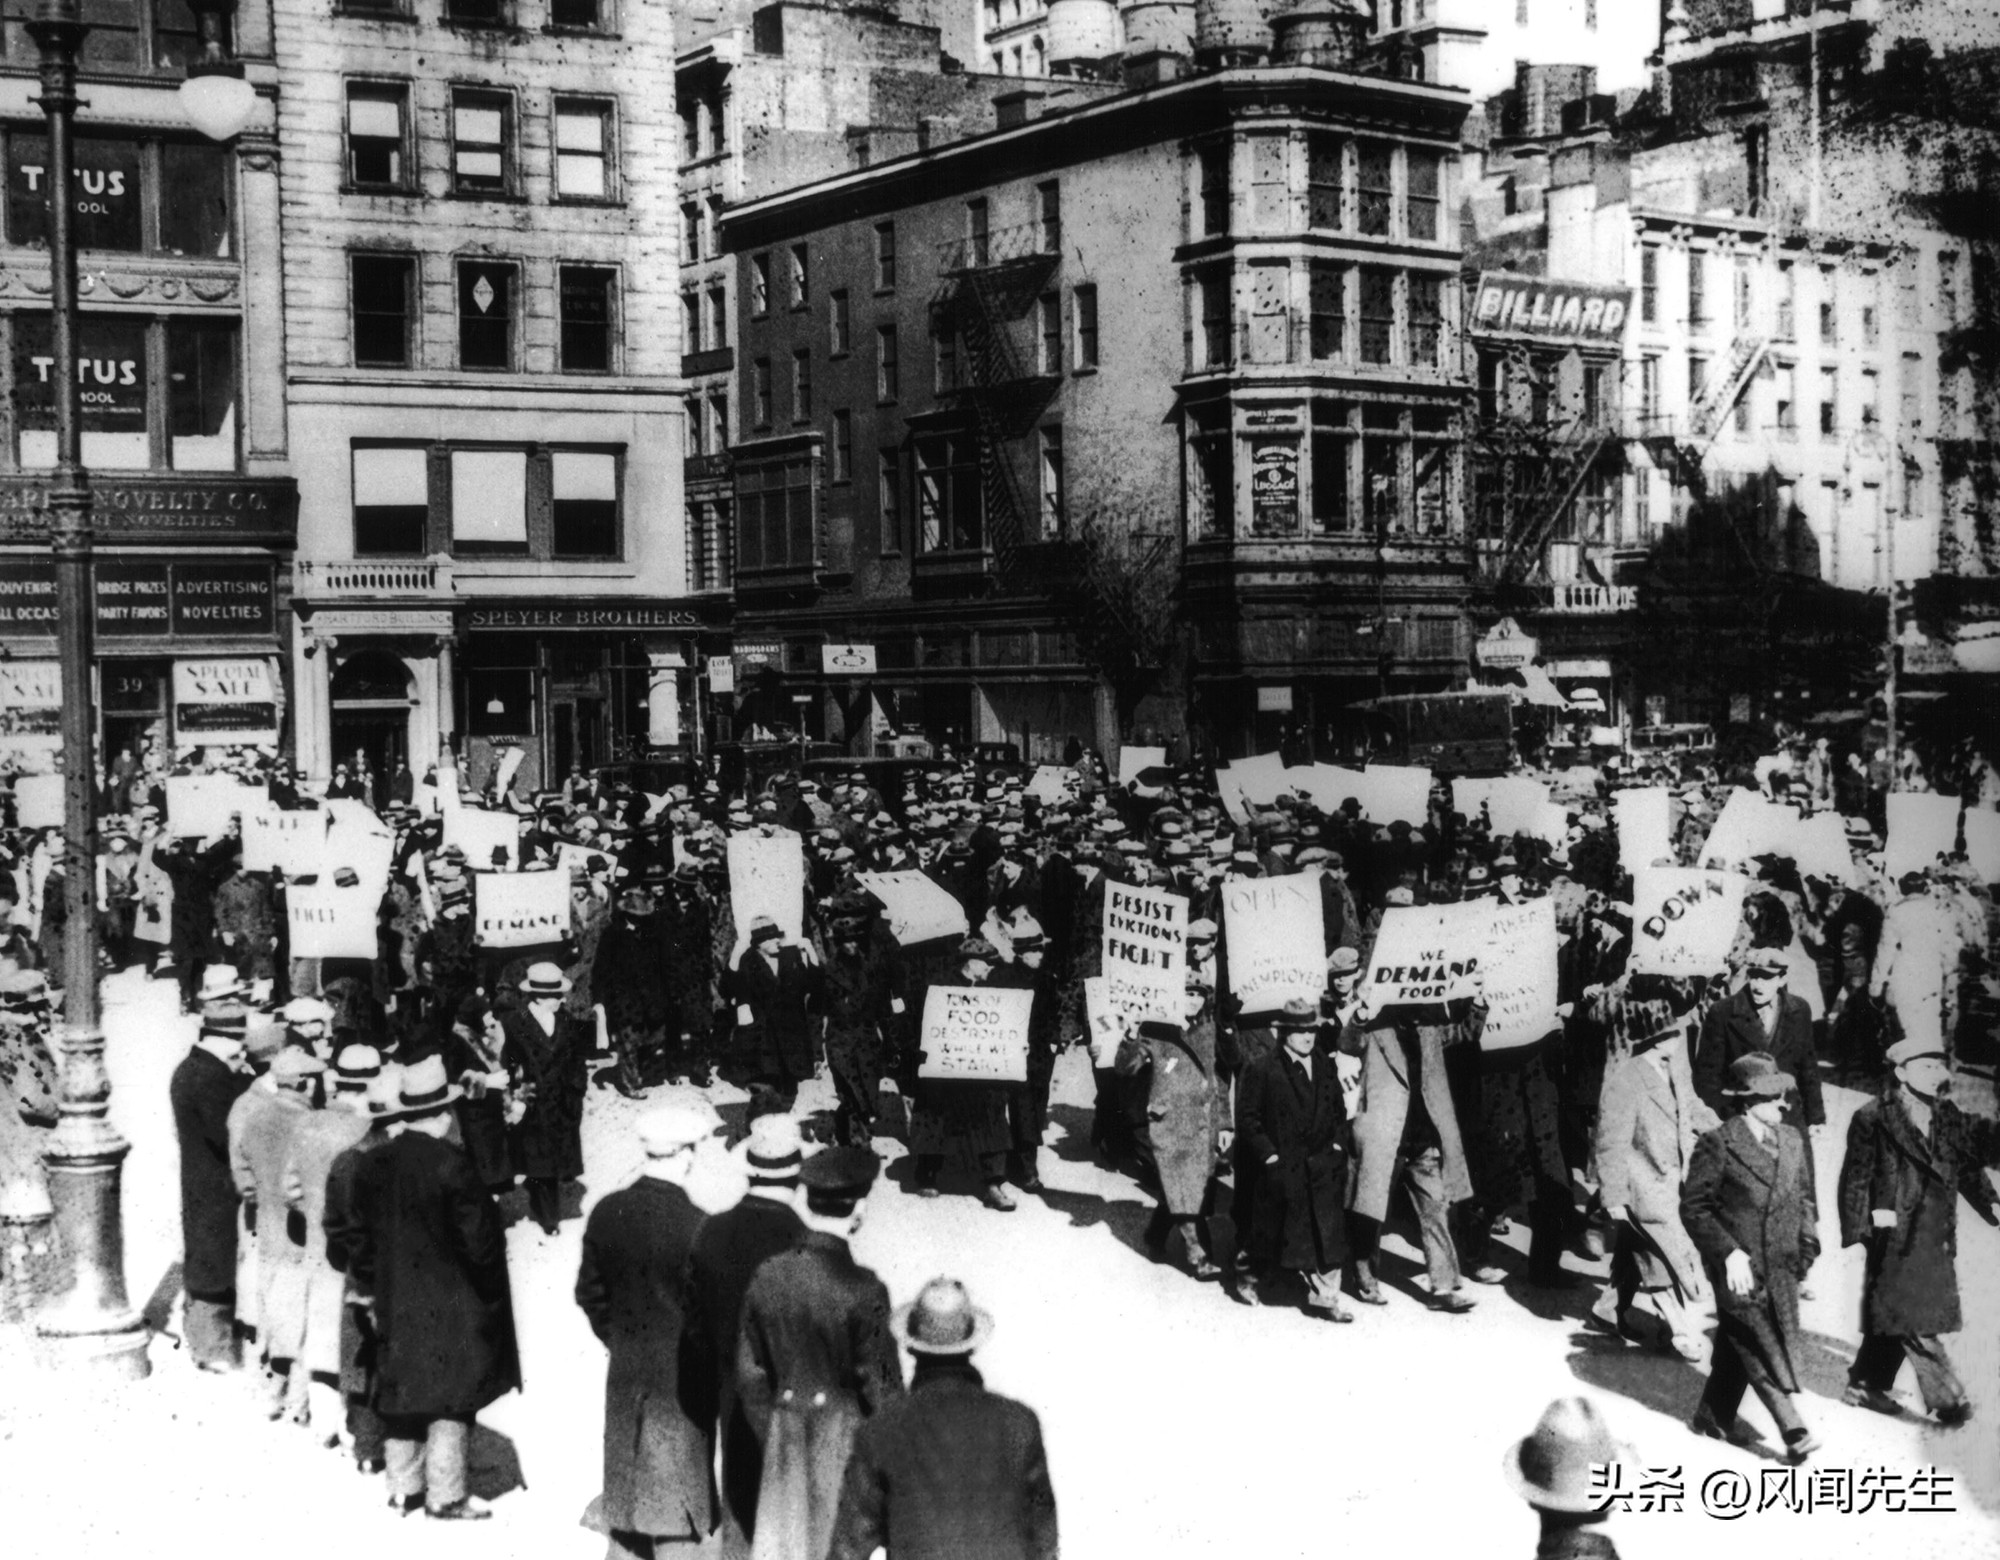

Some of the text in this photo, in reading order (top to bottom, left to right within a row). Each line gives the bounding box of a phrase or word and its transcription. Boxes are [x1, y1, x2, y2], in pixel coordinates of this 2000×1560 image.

[21, 165, 125, 196] TUS
[1477, 287, 1625, 335] BILLIARD
[31, 356, 137, 386] TTUS
[92, 489, 217, 510] NOVELTY
[229, 491, 267, 510] CO.
[125, 514, 237, 527] NOVELTIES
[176, 581, 269, 594] ADVERTISING
[16, 606, 60, 620] OCCAS
[97, 606, 168, 619] PARTY FAVORS
[182, 606, 262, 619] NOVELTIES
[472, 610, 697, 625] SPEYER BROTHERS
[187, 665, 260, 679] SPECIAL
[117, 677, 143, 692] 39
[196, 681, 254, 695] SALE
[1112, 891, 1176, 922] RESIST
[1642, 878, 1724, 941] DOWN
[1109, 912, 1182, 943] EVICTIONS
[1108, 938, 1175, 969] FIGHT
[1420, 948, 1445, 961] WE
[1374, 957, 1478, 984] DEMAND
[948, 1009, 1001, 1025] FOOD
[930, 1026, 1018, 1039] DESTROYED
